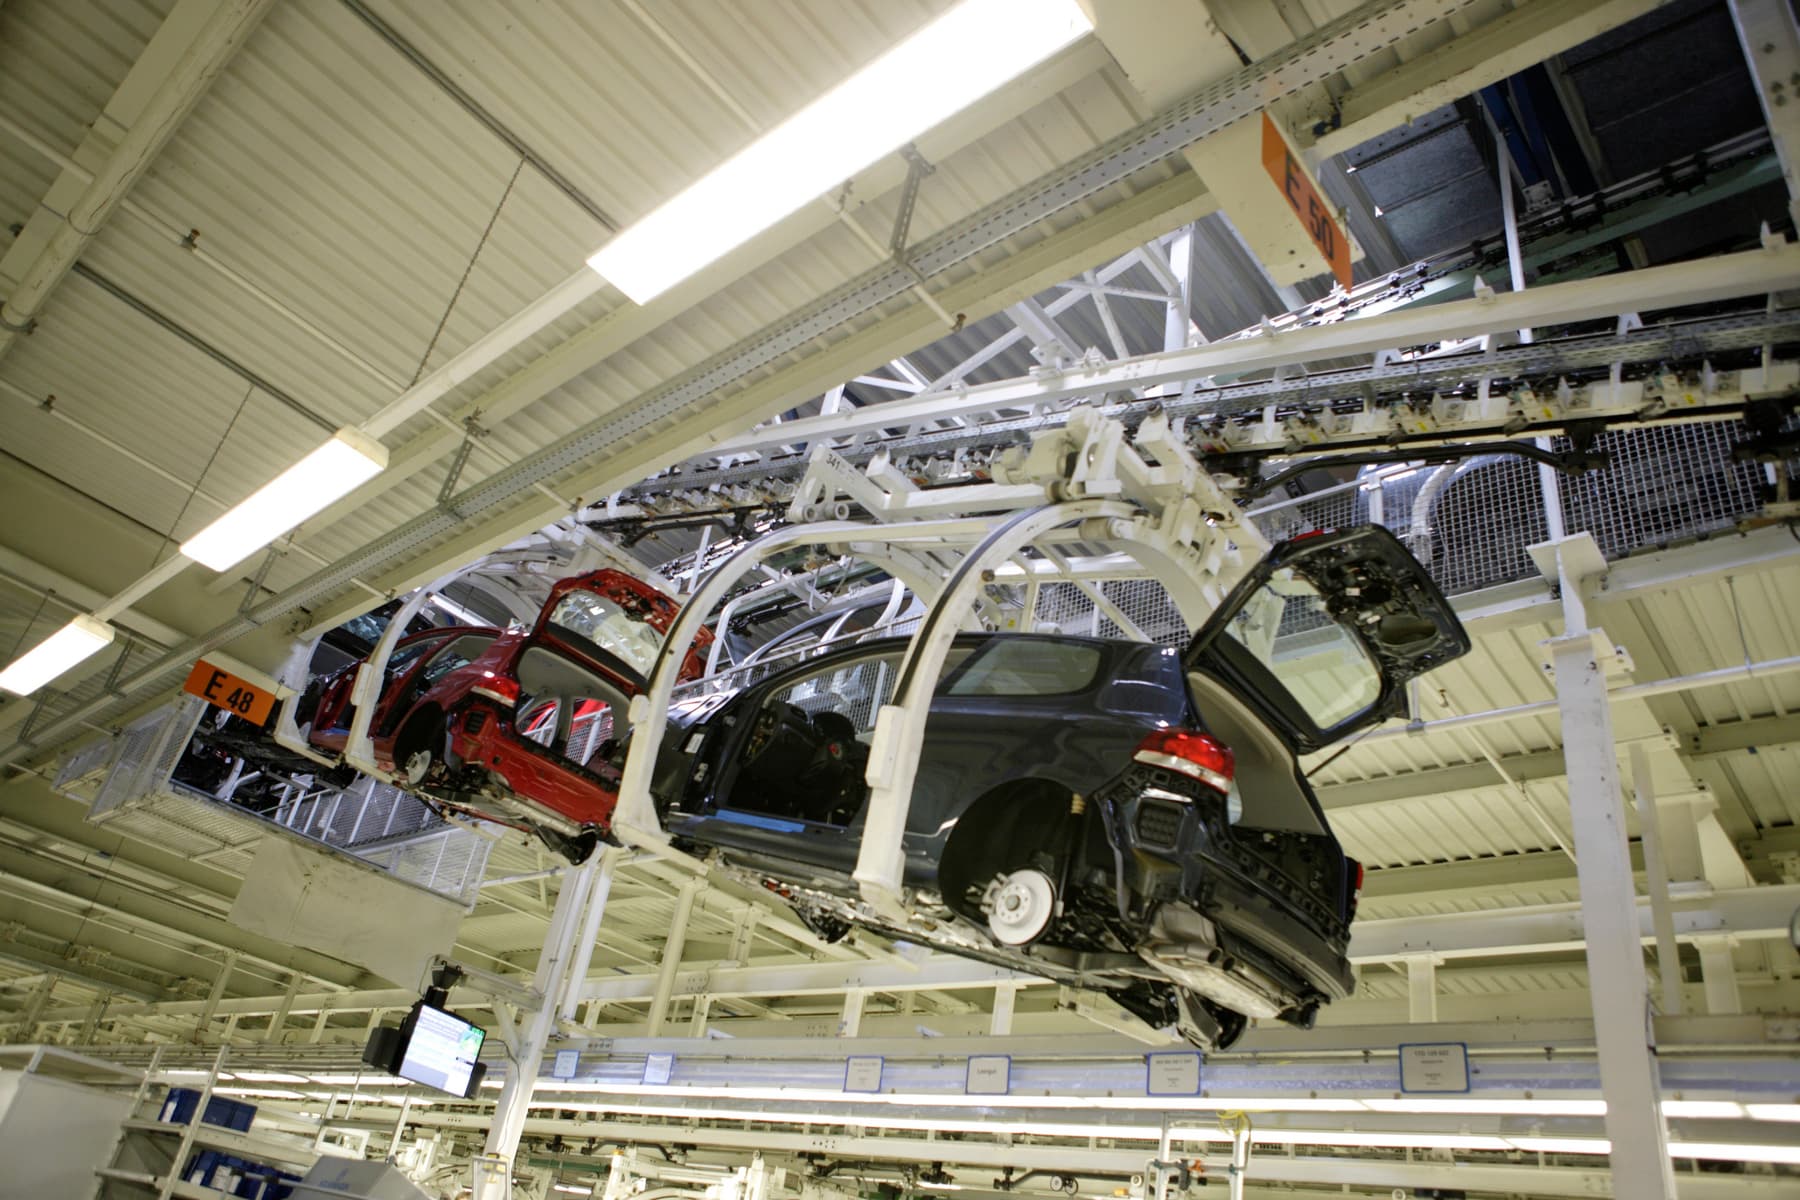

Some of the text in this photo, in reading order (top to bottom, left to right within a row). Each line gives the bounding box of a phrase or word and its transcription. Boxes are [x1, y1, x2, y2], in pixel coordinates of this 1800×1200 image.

[1285, 150, 1335, 261] E 50
[826, 454, 841, 470] 341
[204, 671, 255, 713] E 48
